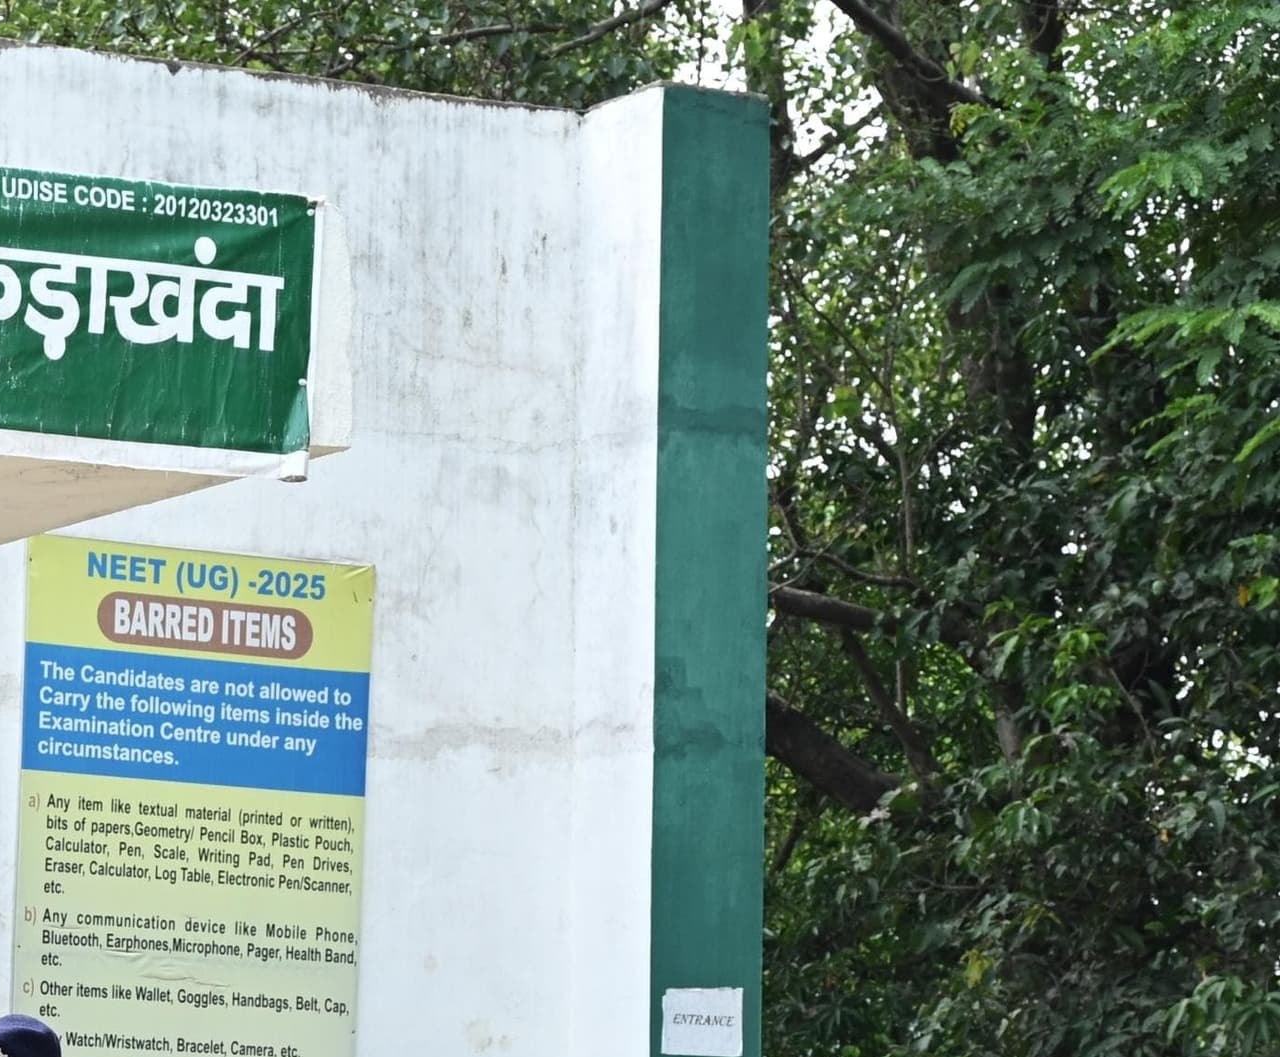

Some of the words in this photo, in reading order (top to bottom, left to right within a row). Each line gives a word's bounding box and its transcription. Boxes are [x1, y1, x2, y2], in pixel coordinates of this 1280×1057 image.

[1, 176, 68, 203] UDISE
[74, 185, 135, 211] CODE
[154, 194, 278, 227] 20120323301
[88, 551, 167, 584] NEET
[176, 561, 239, 597] (UG)
[248, 570, 326, 600] -2025
[114, 598, 214, 642] BARRED
[222, 609, 296, 651] ITEMS
[40, 660, 75, 681] The
[80, 664, 185, 692] Candidates
[190, 679, 219, 695] are
[225, 681, 255, 698] not
[259, 682, 329, 704] allowed
[334, 688, 352, 706] to
[40, 686, 91, 712] Carry
[96, 692, 125, 711] the
[130, 694, 215, 723] following
[221, 702, 270, 724] items
[276, 707, 330, 729] inside
[334, 712, 363, 731] the
[38, 738, 179, 765] circumstances.
[39, 710, 154, 738] Examination
[160, 722, 221, 744] Centre
[226, 730, 280, 749] under
[284, 736, 317, 756] any
[46, 793, 71, 813] Any
[78, 796, 103, 812] item
[111, 798, 131, 814] like
[138, 802, 178, 818] textual
[185, 807, 231, 822] material
[238, 809, 283, 827] (printed
[290, 816, 303, 828] or
[309, 815, 355, 835] written),
[46, 815, 68, 831] bits
[74, 818, 86, 832] of
[200, 826, 235, 843] Pencil
[240, 830, 266, 847] Box,
[272, 832, 310, 849] Plastic
[315, 835, 354, 854] Pouch,
[46, 836, 110, 857] Calculator,
[119, 841, 145, 859] Pen,
[154, 844, 189, 863] Scale,
[198, 847, 240, 869] Writing
[248, 851, 274, 869] Pad,
[282, 854, 305, 869] Pen
[313, 856, 353, 875] Drives,
[44, 880, 65, 894] etc.
[45, 857, 85, 876] Eraser,
[89, 860, 151, 881] Calculator,
[155, 865, 177, 885] Log
[180, 867, 214, 886] Table,
[218, 870, 275, 888] Electronic
[278, 874, 352, 896] Pen/Scanner,
[42, 908, 68, 928] Any
[76, 913, 176, 931] communication
[184, 917, 226, 934] device
[234, 921, 257, 937] like
[266, 923, 307, 940] Mobile
[315, 926, 358, 946] Phone,
[41, 952, 62, 967] etc.
[42, 929, 102, 949] Bluetooth,
[247, 942, 282, 962] Pager,
[286, 945, 321, 962] Health
[324, 948, 357, 967] Band,
[39, 1003, 60, 1017] etc.
[40, 980, 73, 996] Other
[76, 982, 108, 999] items
[112, 984, 132, 1000] like
[135, 986, 173, 1004] Wallet,
[177, 988, 228, 1009] Goggles,
[232, 992, 292, 1013] Handbags,
[296, 996, 321, 1014] Belt,
[324, 998, 349, 1017] Cap,
[672, 1013, 735, 1027] ENTRANCE
[65, 1032, 173, 1053] Watch/Wristwatch,
[176, 1038, 227, 1056] Bracelet,
